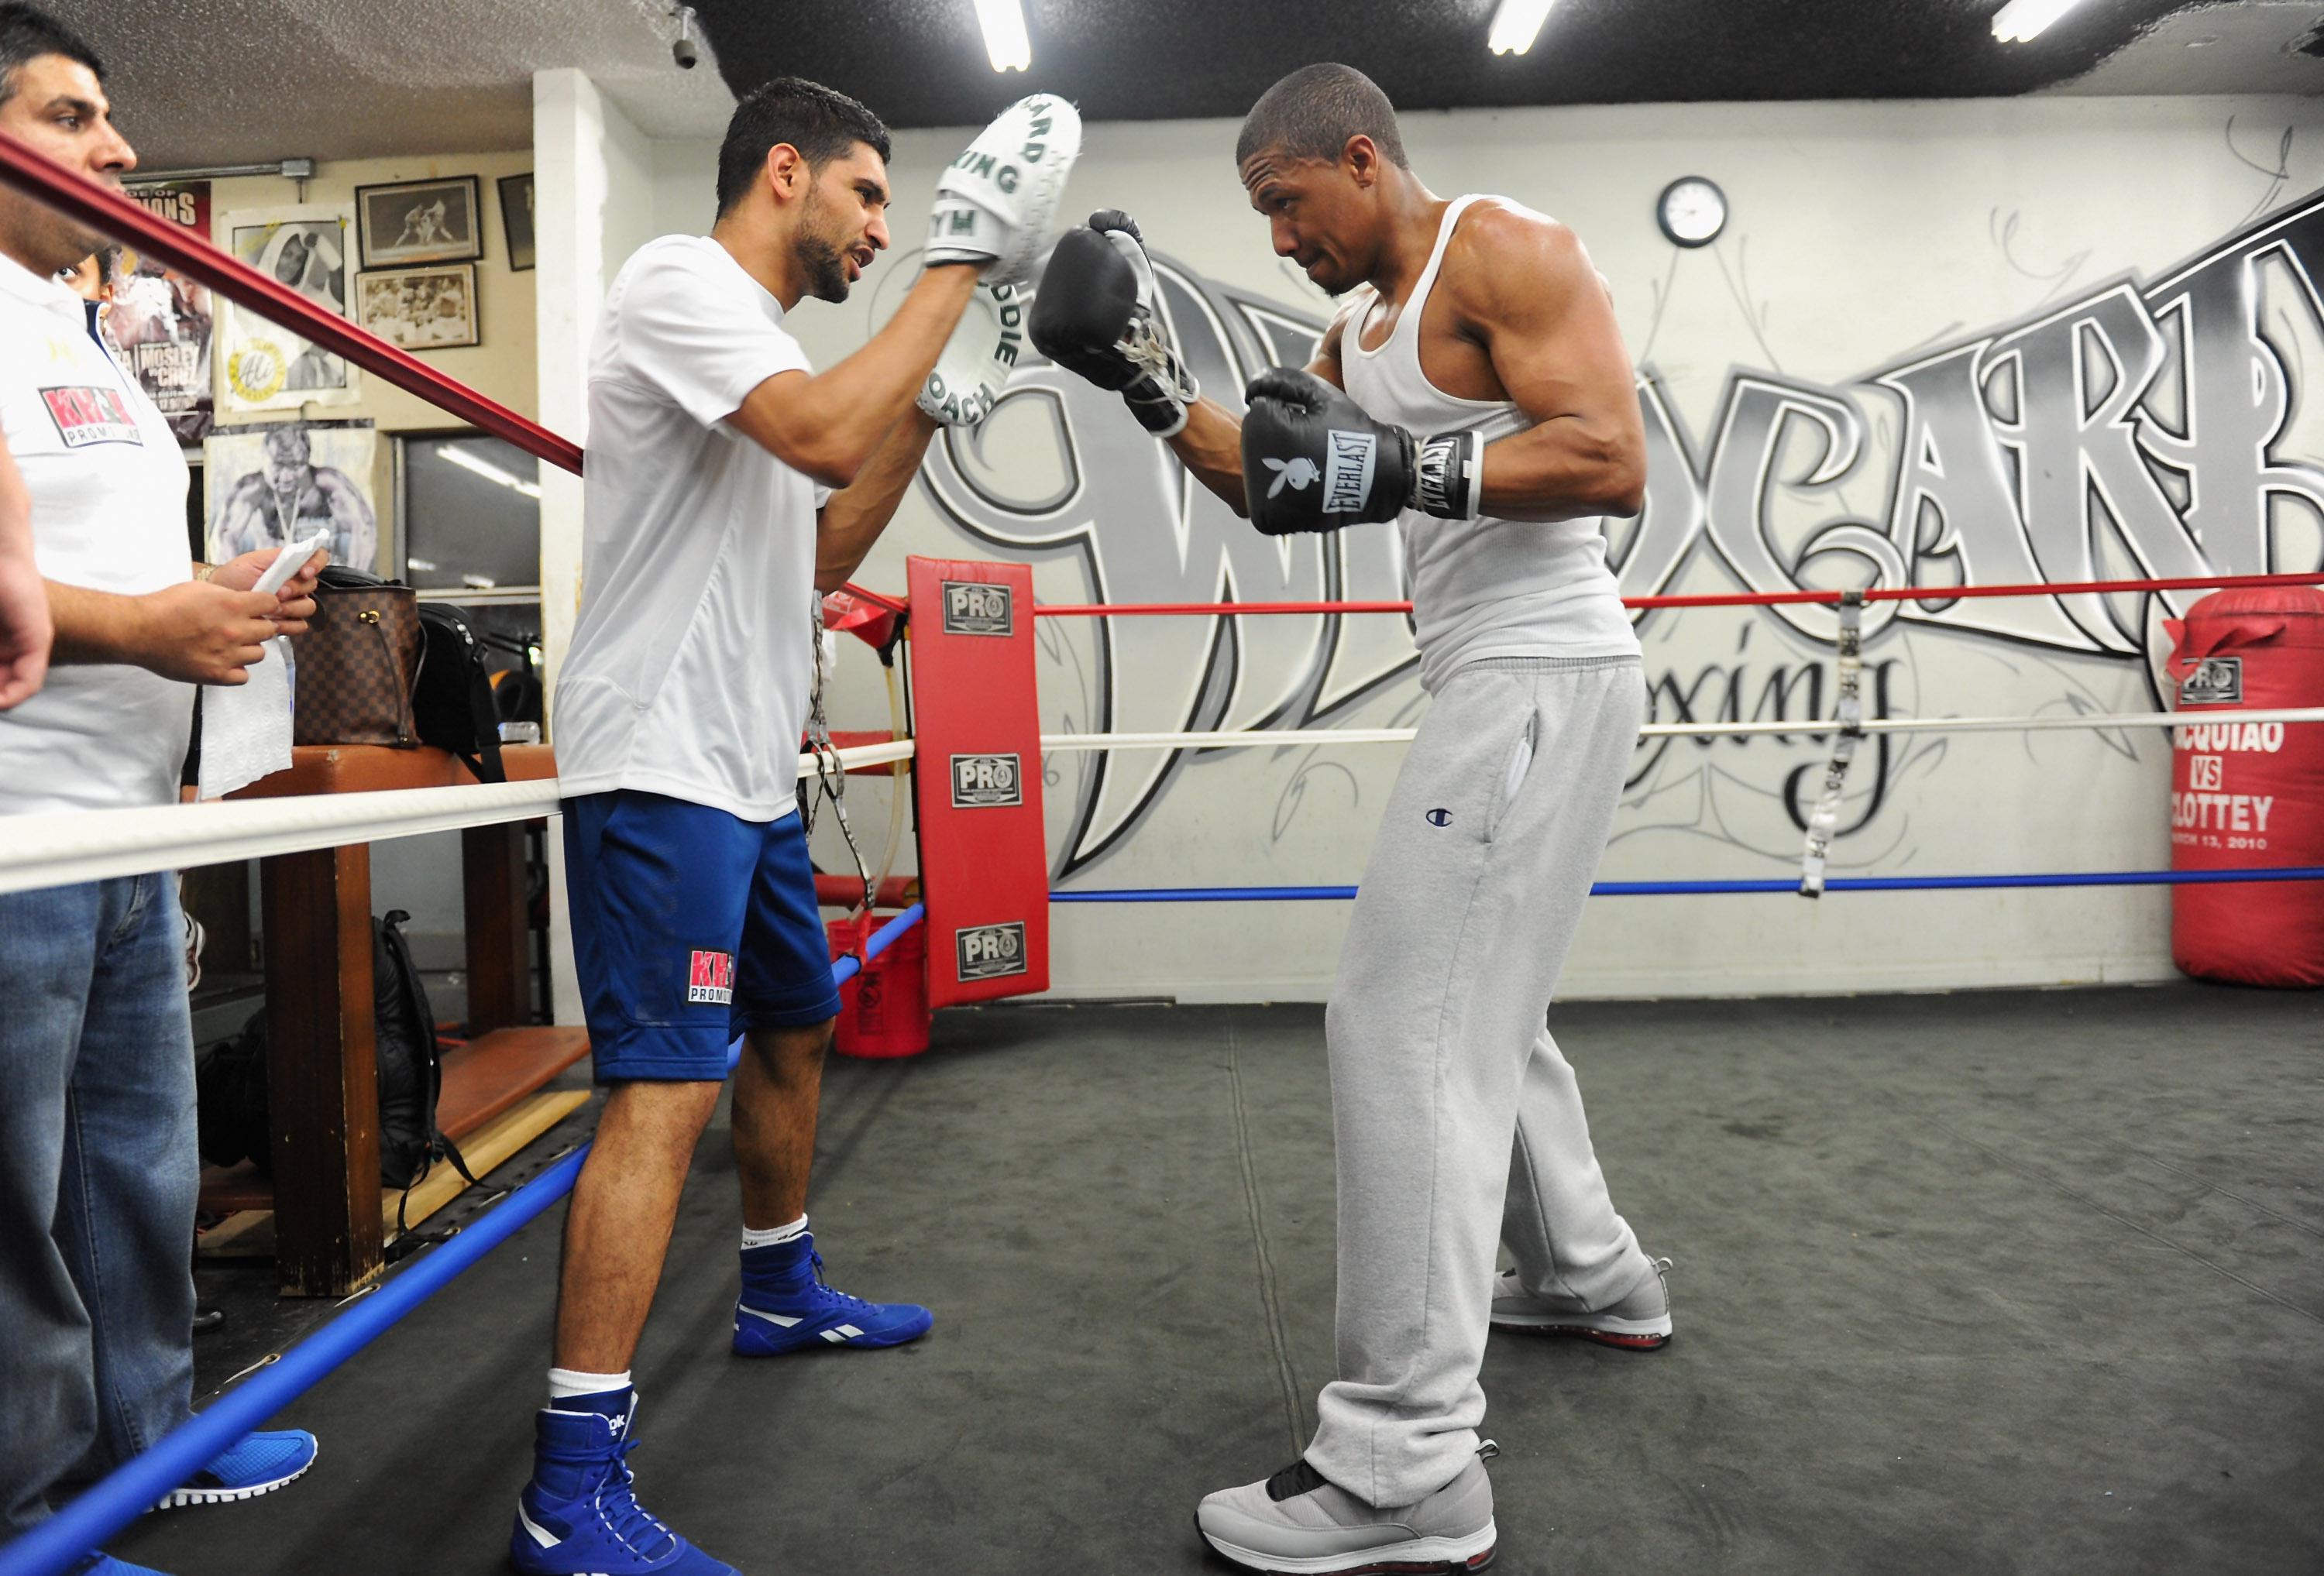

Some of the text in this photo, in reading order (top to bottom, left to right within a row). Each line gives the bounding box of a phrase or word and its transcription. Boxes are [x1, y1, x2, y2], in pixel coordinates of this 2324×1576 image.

[990, 284, 1022, 367] DDIE
[140, 345, 200, 370] MOSLEY
[928, 372, 995, 424] OACH
[1326, 433, 1372, 510] EVERLAST
[951, 592, 1005, 618] PRO
[960, 764, 1012, 789] PRO
[2195, 758, 2219, 787] VS
[2227, 836, 2267, 850] 2010
[964, 934, 1018, 962] PRO
